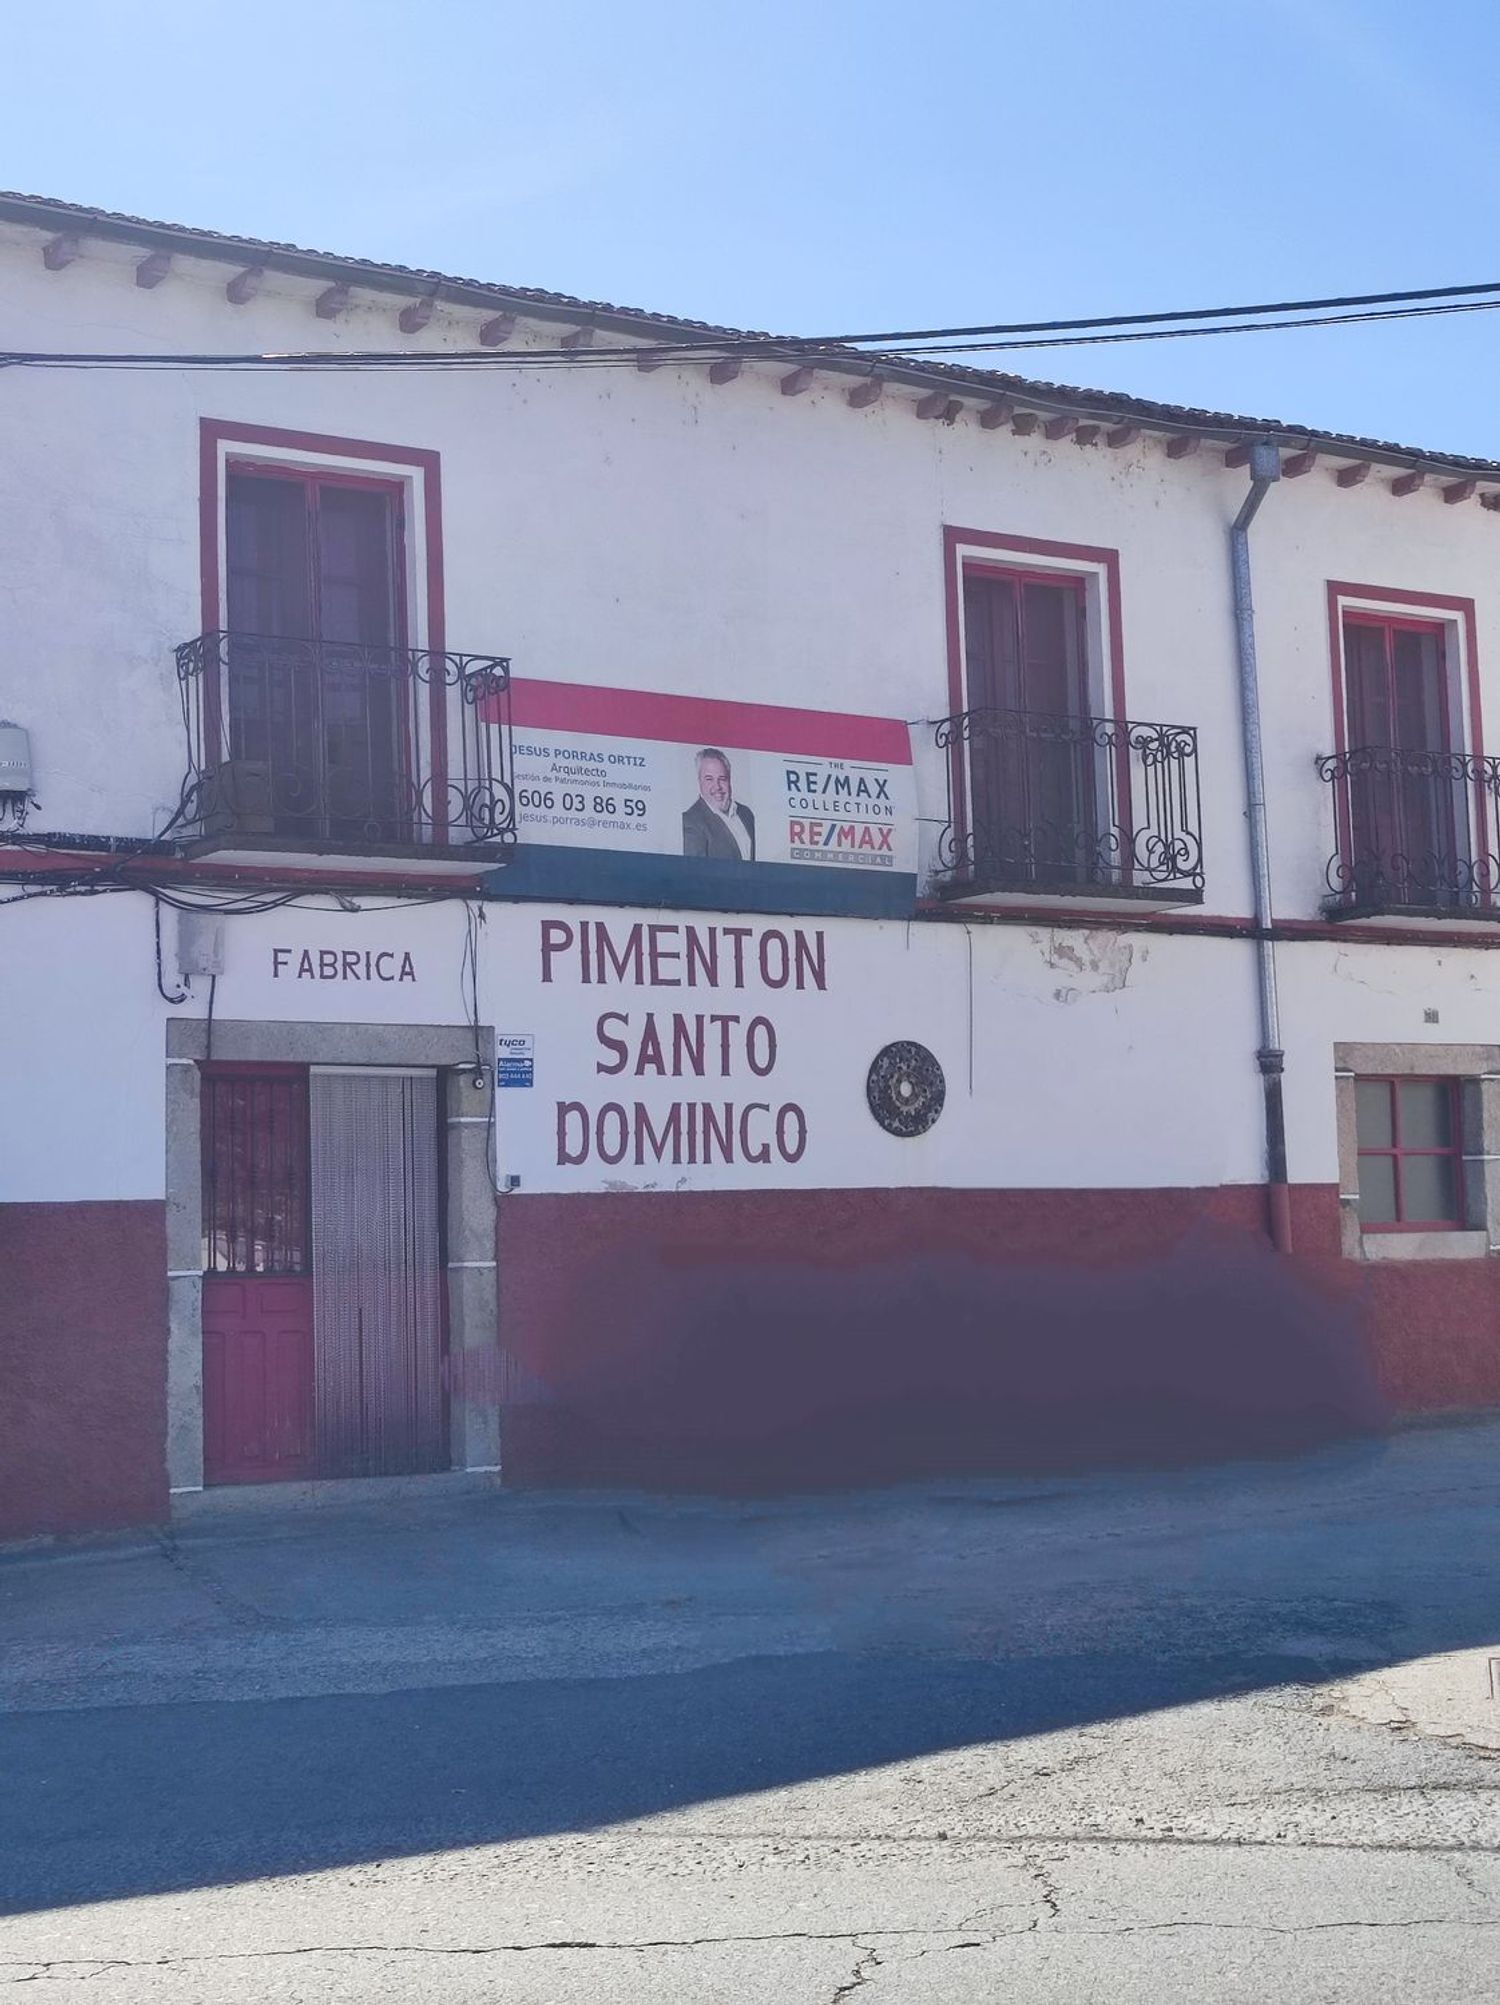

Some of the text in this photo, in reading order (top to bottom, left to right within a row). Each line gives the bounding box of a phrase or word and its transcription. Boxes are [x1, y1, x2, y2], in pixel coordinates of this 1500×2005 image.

[512, 745, 647, 768] JESUS PORRAS ORTIZ
[829, 761, 844, 770] THE
[550, 763, 607, 778] Arquitecto
[542, 774, 553, 783] de
[554, 776, 600, 788] Patrimonios
[602, 780, 652, 793] Inmobiliarios
[786, 769, 890, 801] RE/MAX
[519, 789, 647, 817] 606 03 86 59
[788, 796, 893, 817] COLLECTION
[517, 812, 648, 832] jesus.porras@remax.es
[789, 819, 894, 852] RE/MAX
[793, 850, 891, 866] COMMERCIAL
[271, 947, 417, 983] FABRICA
[540, 919, 828, 991] PIMENTON
[499, 1038, 526, 1048] tyco
[596, 1011, 778, 1077] SANTO
[556, 1100, 808, 1166] DOMINGO
